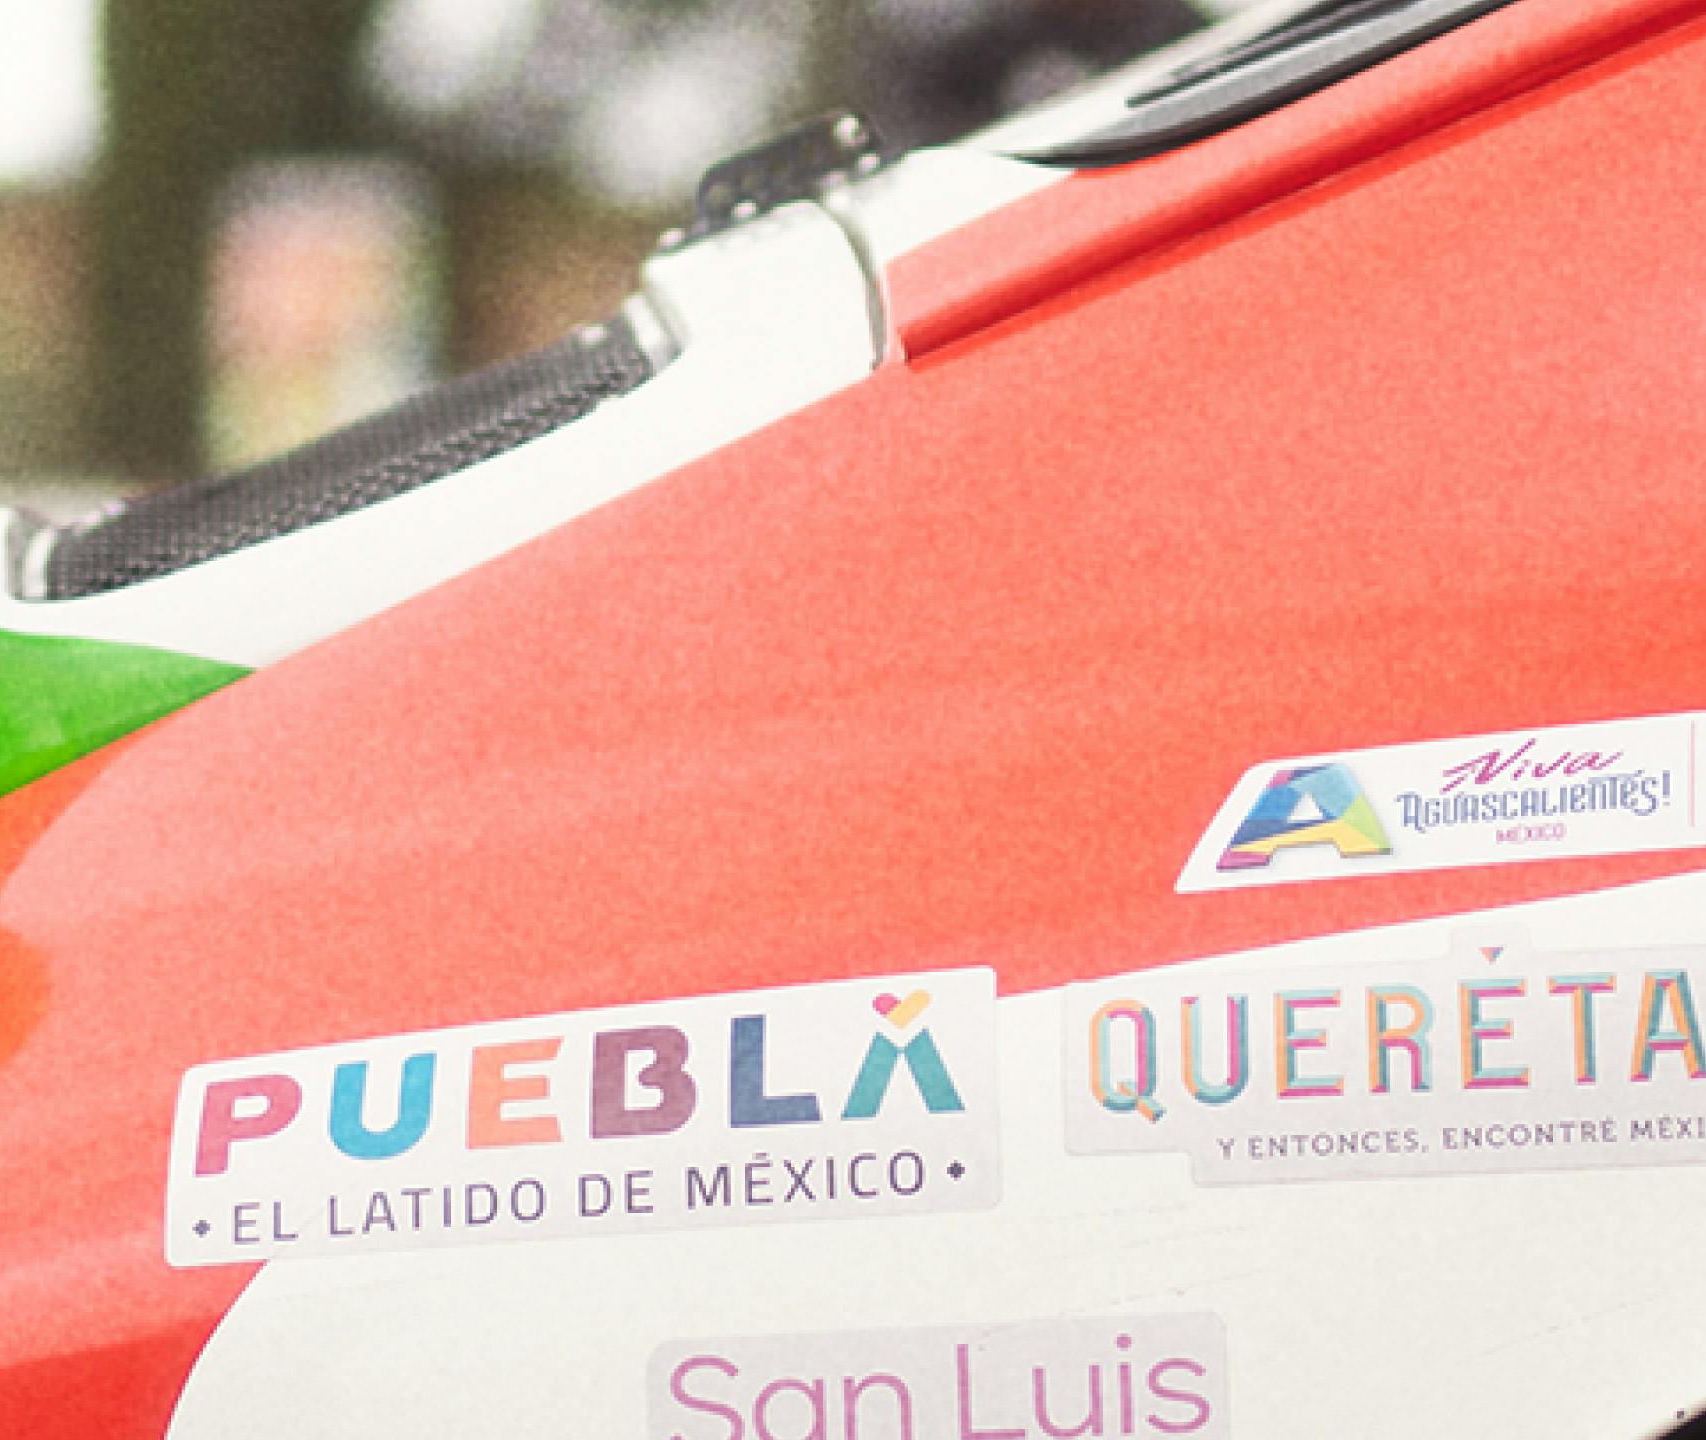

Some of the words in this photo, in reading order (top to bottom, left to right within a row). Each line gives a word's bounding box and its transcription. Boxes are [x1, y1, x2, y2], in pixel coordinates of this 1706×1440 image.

[195, 990, 966, 1178] PUEBLA
[1217, 1137, 1235, 1161] Y
[234, 1202, 298, 1244] EL
[329, 1177, 547, 1235] LATIDO
[578, 1170, 654, 1216] DE
[686, 1151, 925, 1210] MÉXICO
